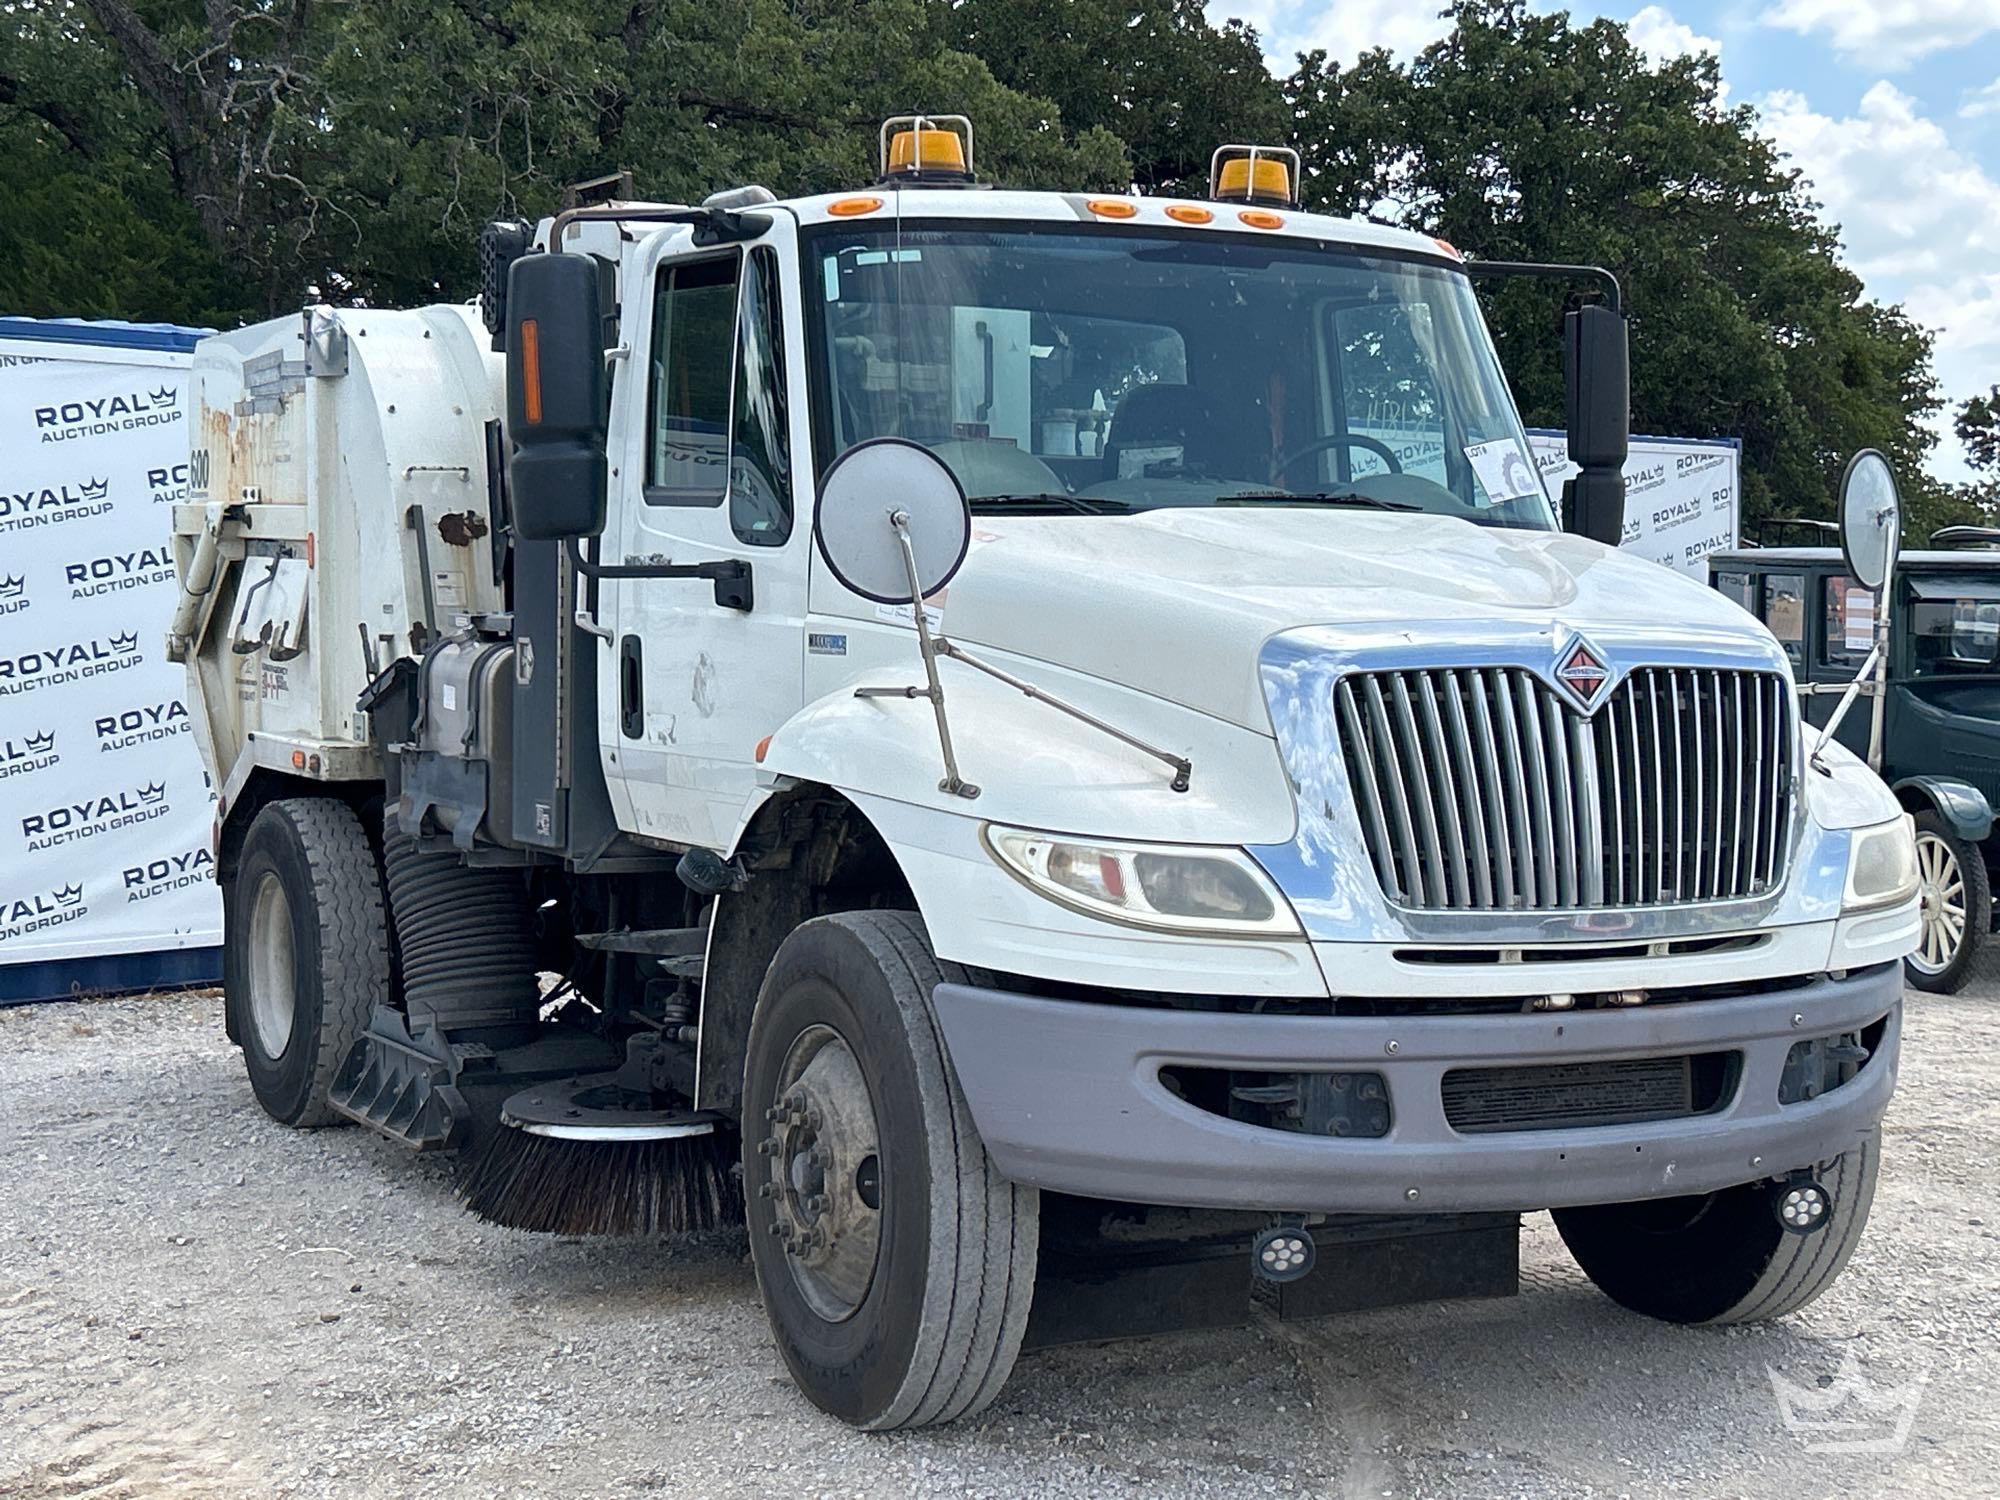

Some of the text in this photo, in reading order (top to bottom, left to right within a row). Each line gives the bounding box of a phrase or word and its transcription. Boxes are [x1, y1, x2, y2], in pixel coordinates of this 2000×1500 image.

[35, 394, 150, 428] ROYAL
[41, 411, 182, 443] AUCTION GROUP
[52, 502, 114, 522] GROUP
[1653, 502, 1691, 525] ROYAL
[1685, 535, 1723, 559] ROYAL
[65, 546, 173, 584] ROYAL
[71, 574, 149, 600] AUCTION
[0, 655, 143, 696] AUCTION GROUP
[101, 725, 177, 752] AUCTION
[22, 792, 138, 837] ROYAL
[28, 804, 170, 852] AUCTION GROUP
[127, 872, 202, 904] AUCTION
[25, 907, 88, 933] GROUP
